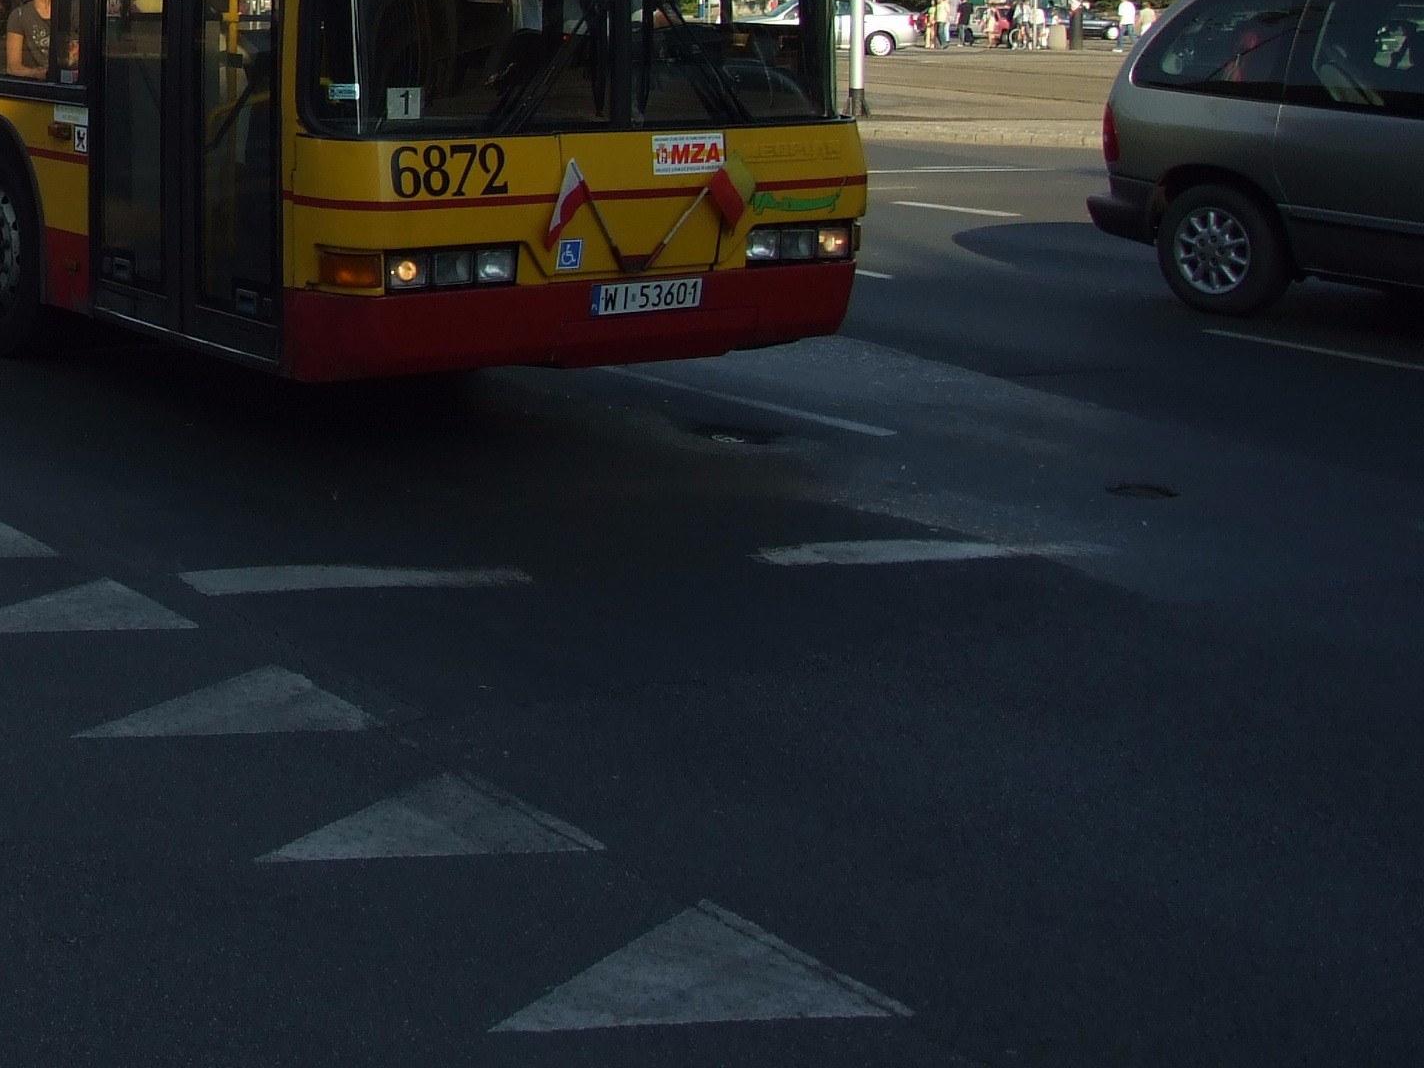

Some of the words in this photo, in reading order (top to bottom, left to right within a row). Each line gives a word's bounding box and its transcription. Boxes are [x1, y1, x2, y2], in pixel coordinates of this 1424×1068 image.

[399, 89, 412, 116] 1
[671, 142, 721, 165] MZA
[390, 142, 509, 199] 6872
[604, 285, 629, 312] WI
[638, 280, 699, 309] 53601
